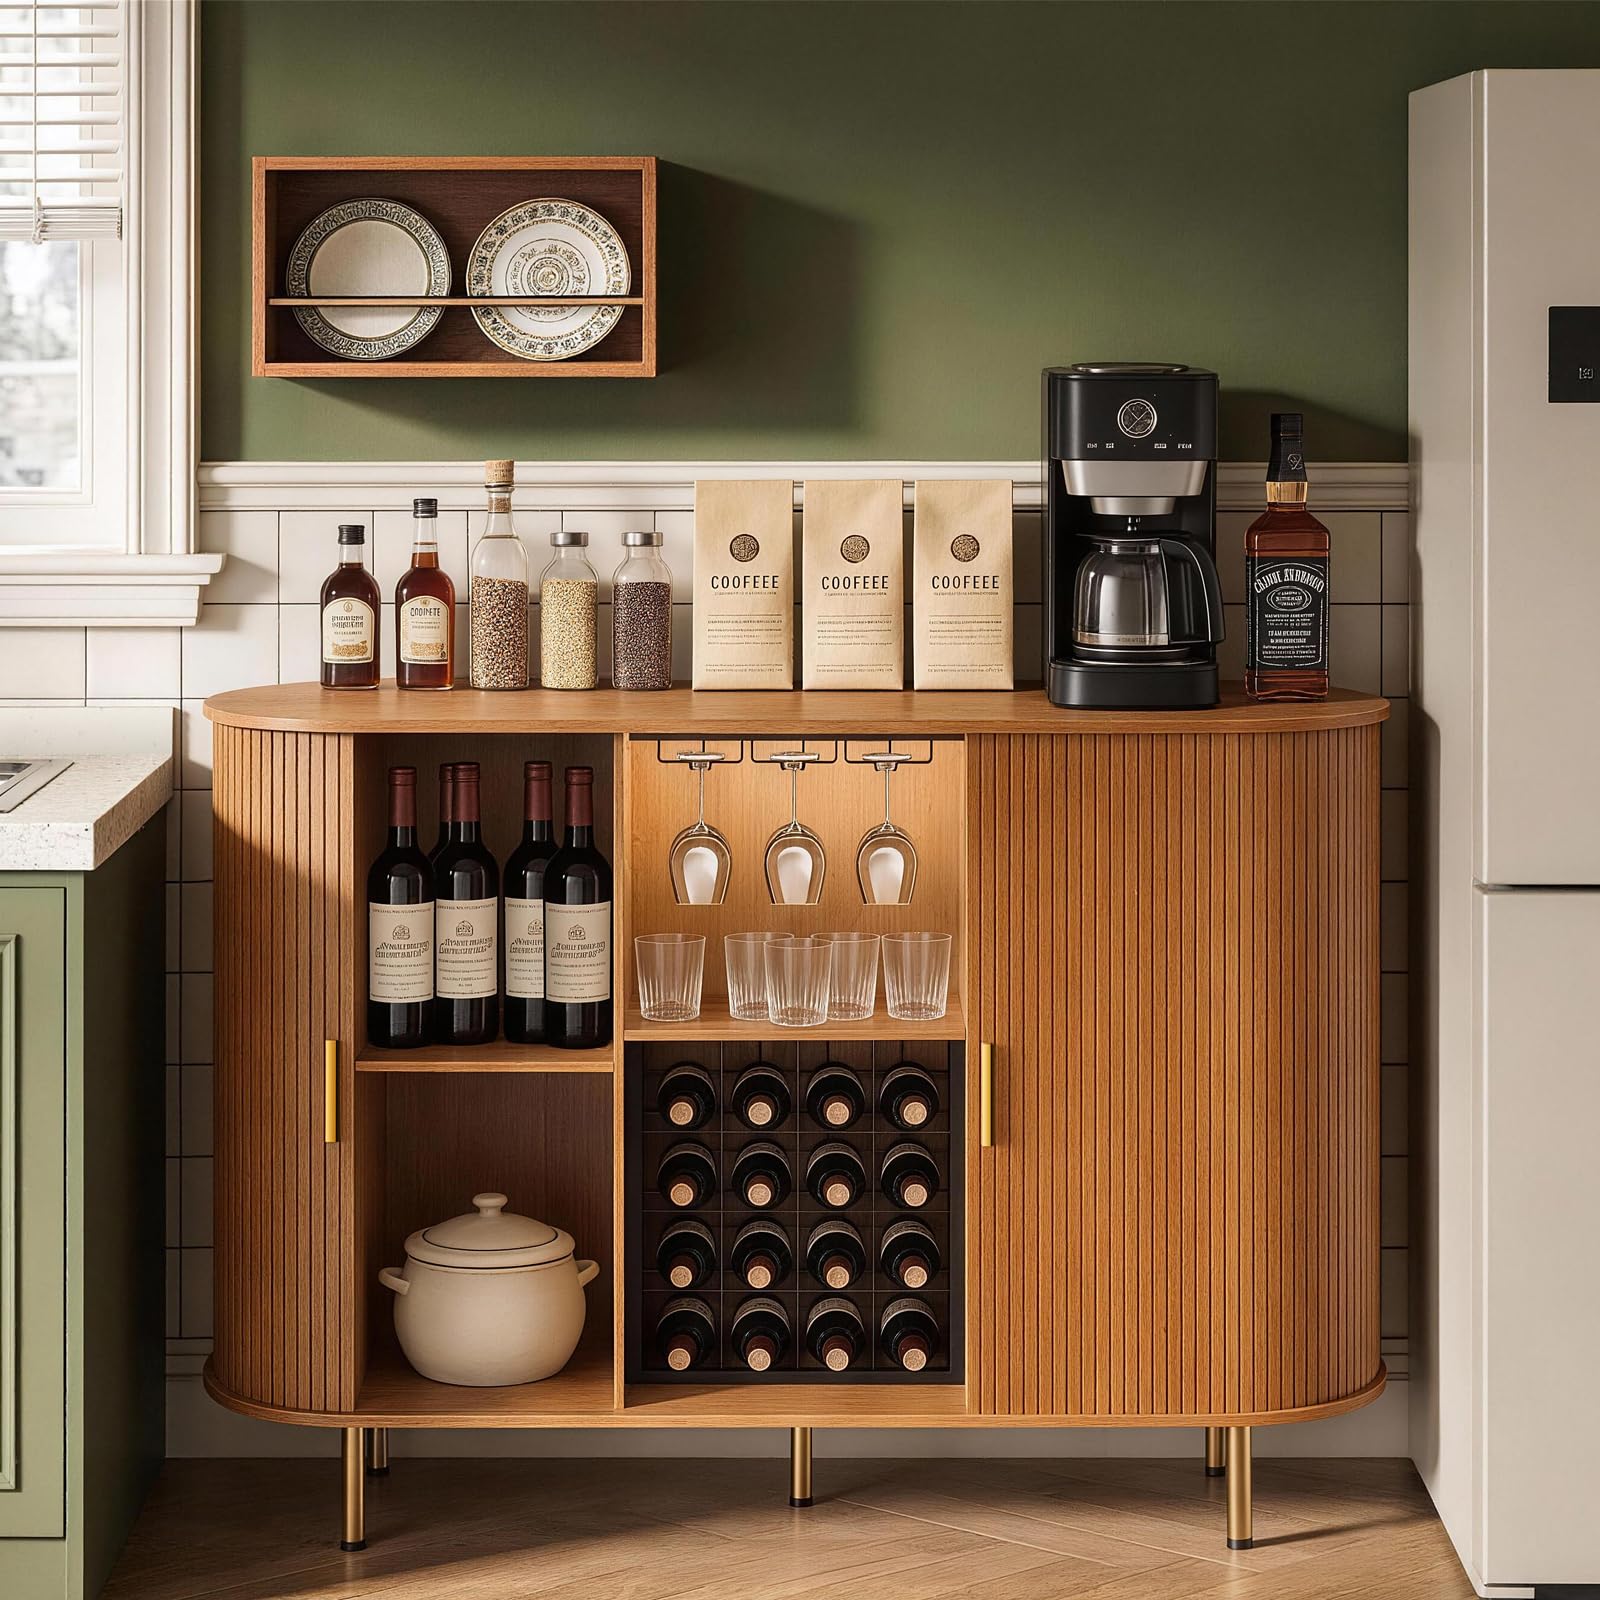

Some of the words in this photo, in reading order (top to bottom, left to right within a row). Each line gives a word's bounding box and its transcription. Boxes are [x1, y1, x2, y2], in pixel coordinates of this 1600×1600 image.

[711, 575, 780, 590] COOFEEE
[821, 575, 889, 590] COOFEEE
[931, 575, 1000, 590] COOFEEE
